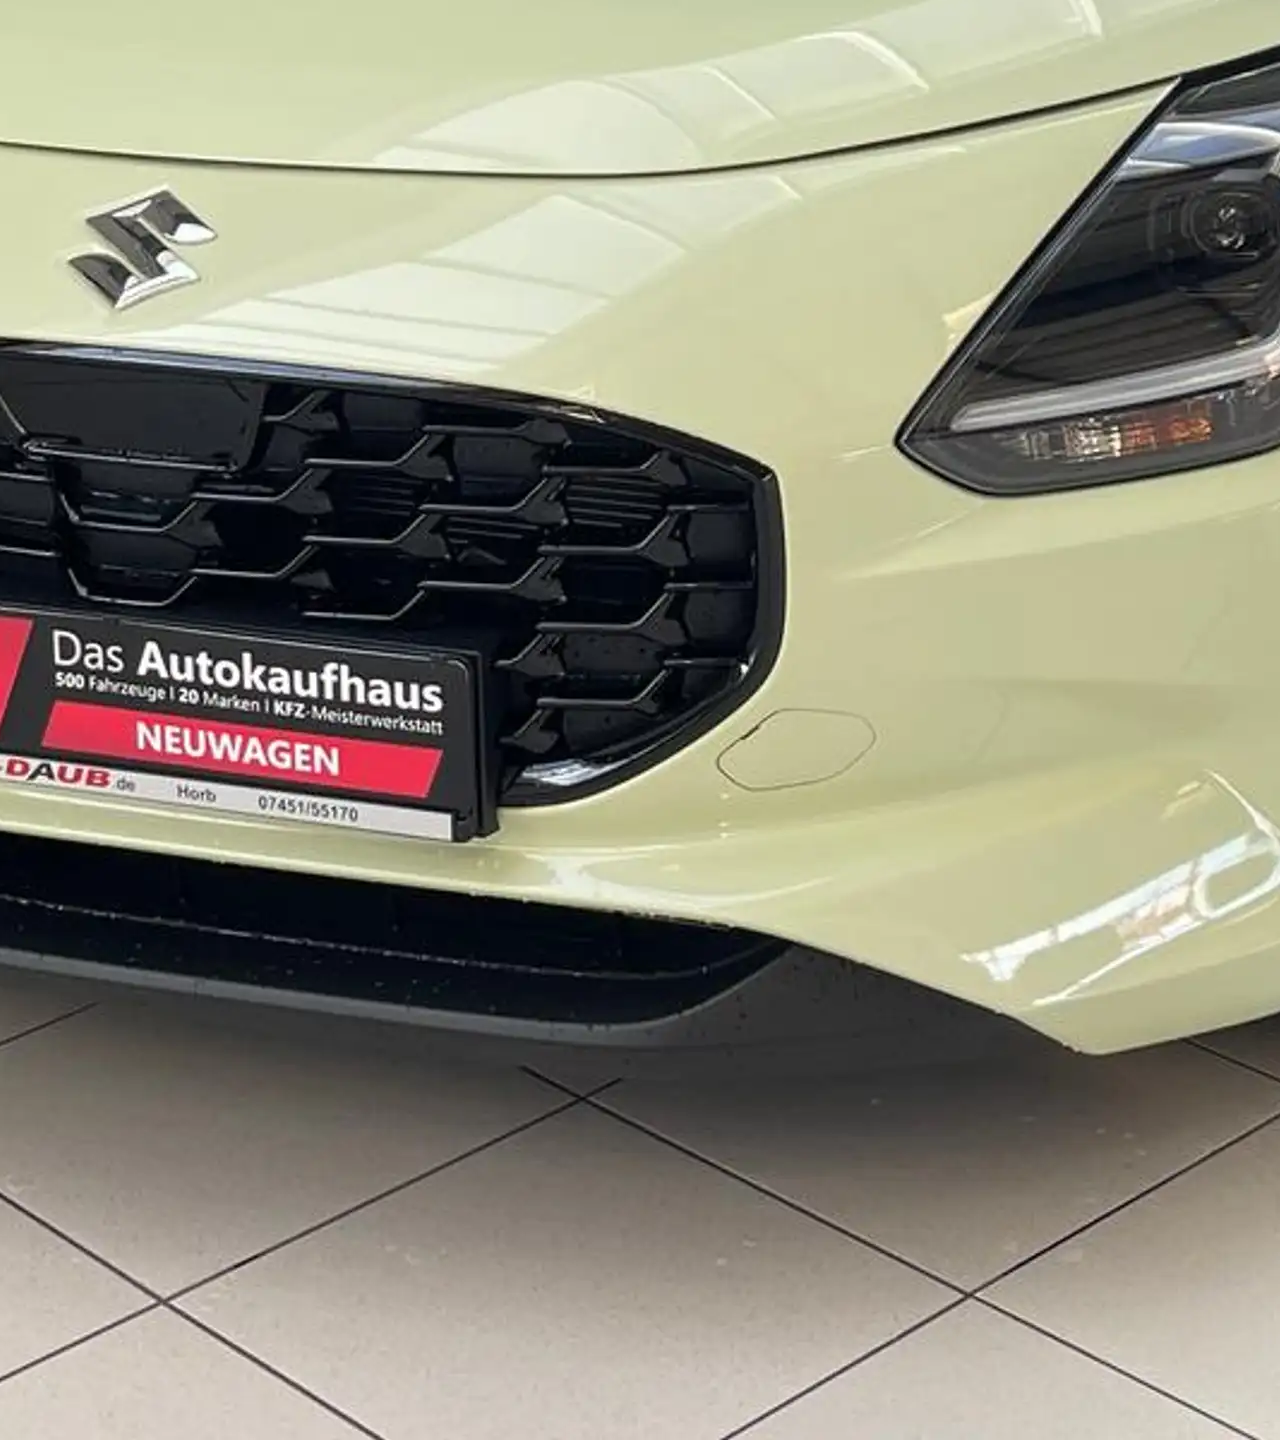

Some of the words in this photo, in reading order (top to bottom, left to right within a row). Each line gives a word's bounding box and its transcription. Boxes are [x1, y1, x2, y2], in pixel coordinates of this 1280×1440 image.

[51, 628, 124, 673] Das
[136, 640, 444, 713] Autokaufhaus
[54, 671, 85, 690] 500
[88, 675, 166, 703] Fahrzeuge
[178, 687, 200, 704] 20
[203, 691, 261, 713] Marken
[273, 700, 444, 736] KFZ-Meisterwerkstatt
[136, 720, 340, 777] NEUWAGEN
[176, 783, 217, 803] Horb
[257, 794, 360, 823] 07451/55170
